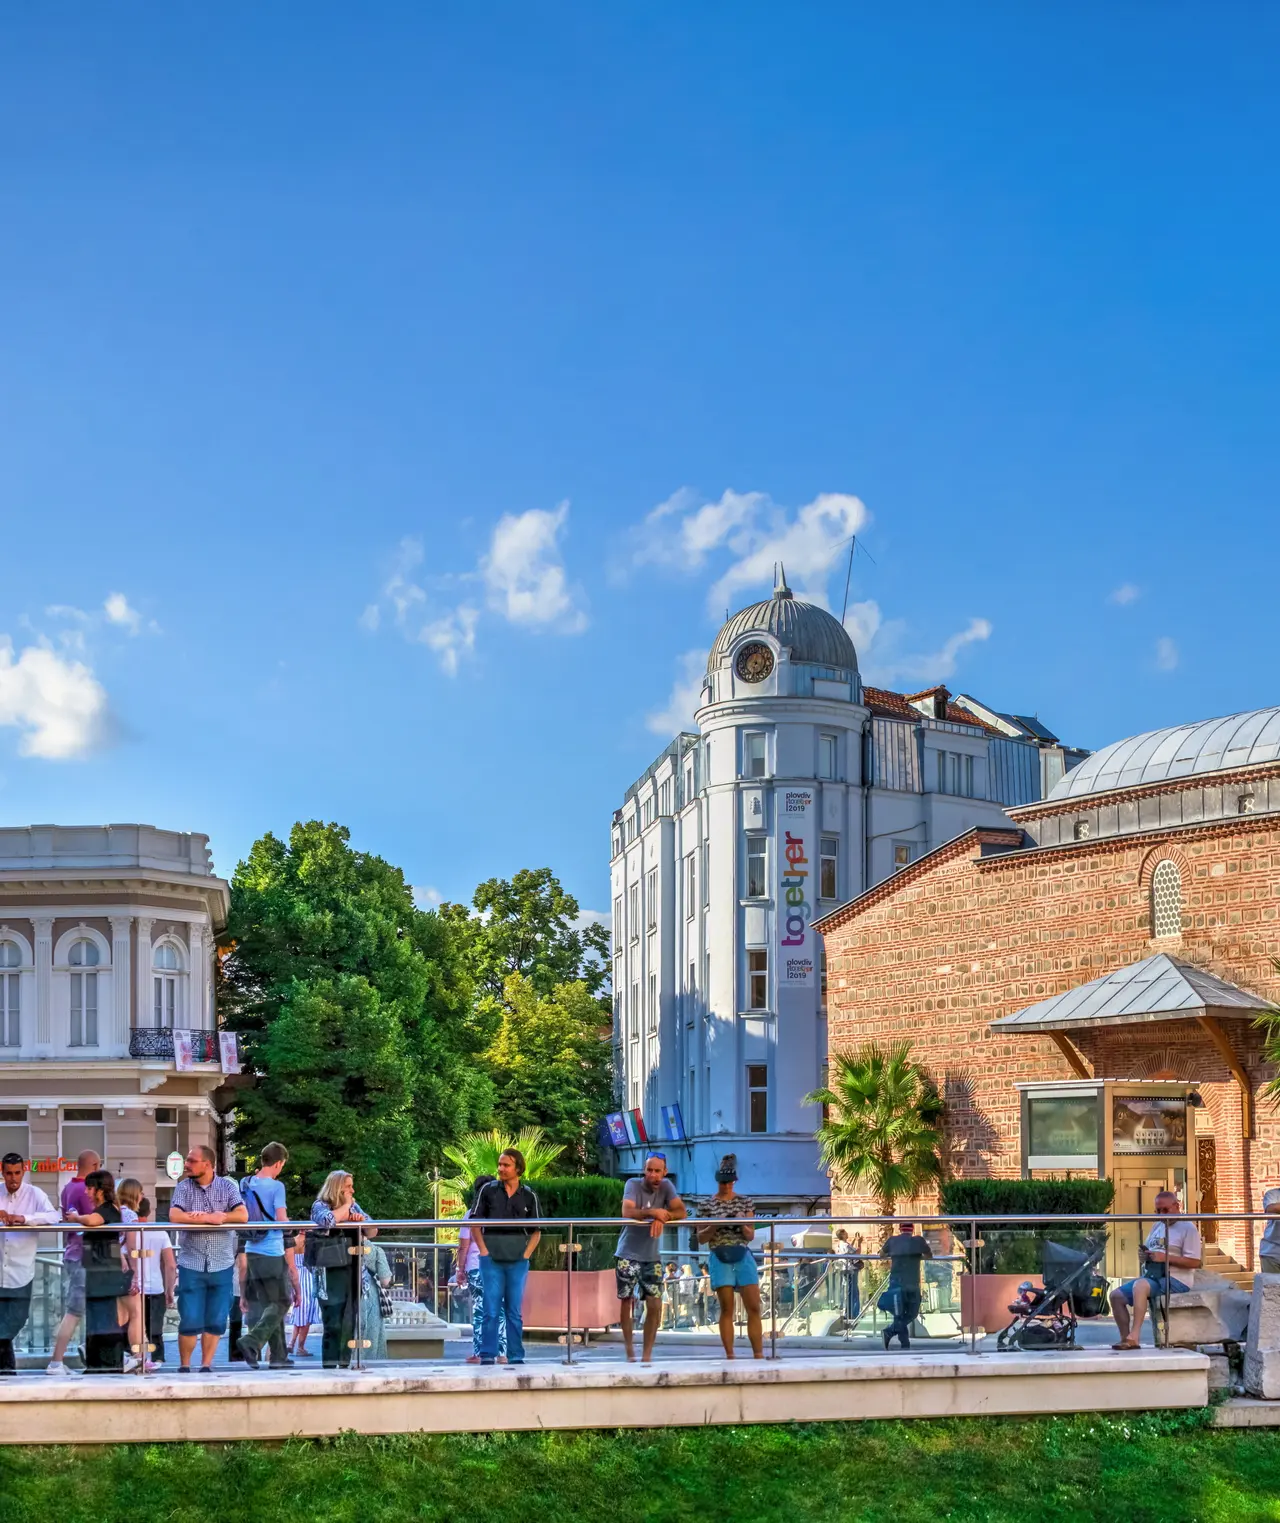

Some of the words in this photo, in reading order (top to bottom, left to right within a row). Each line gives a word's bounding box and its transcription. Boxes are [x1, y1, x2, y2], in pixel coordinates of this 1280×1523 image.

[786, 791, 811, 799] plovdiv
[781, 831, 811, 946] together
[787, 958, 812, 966] plovdiv
